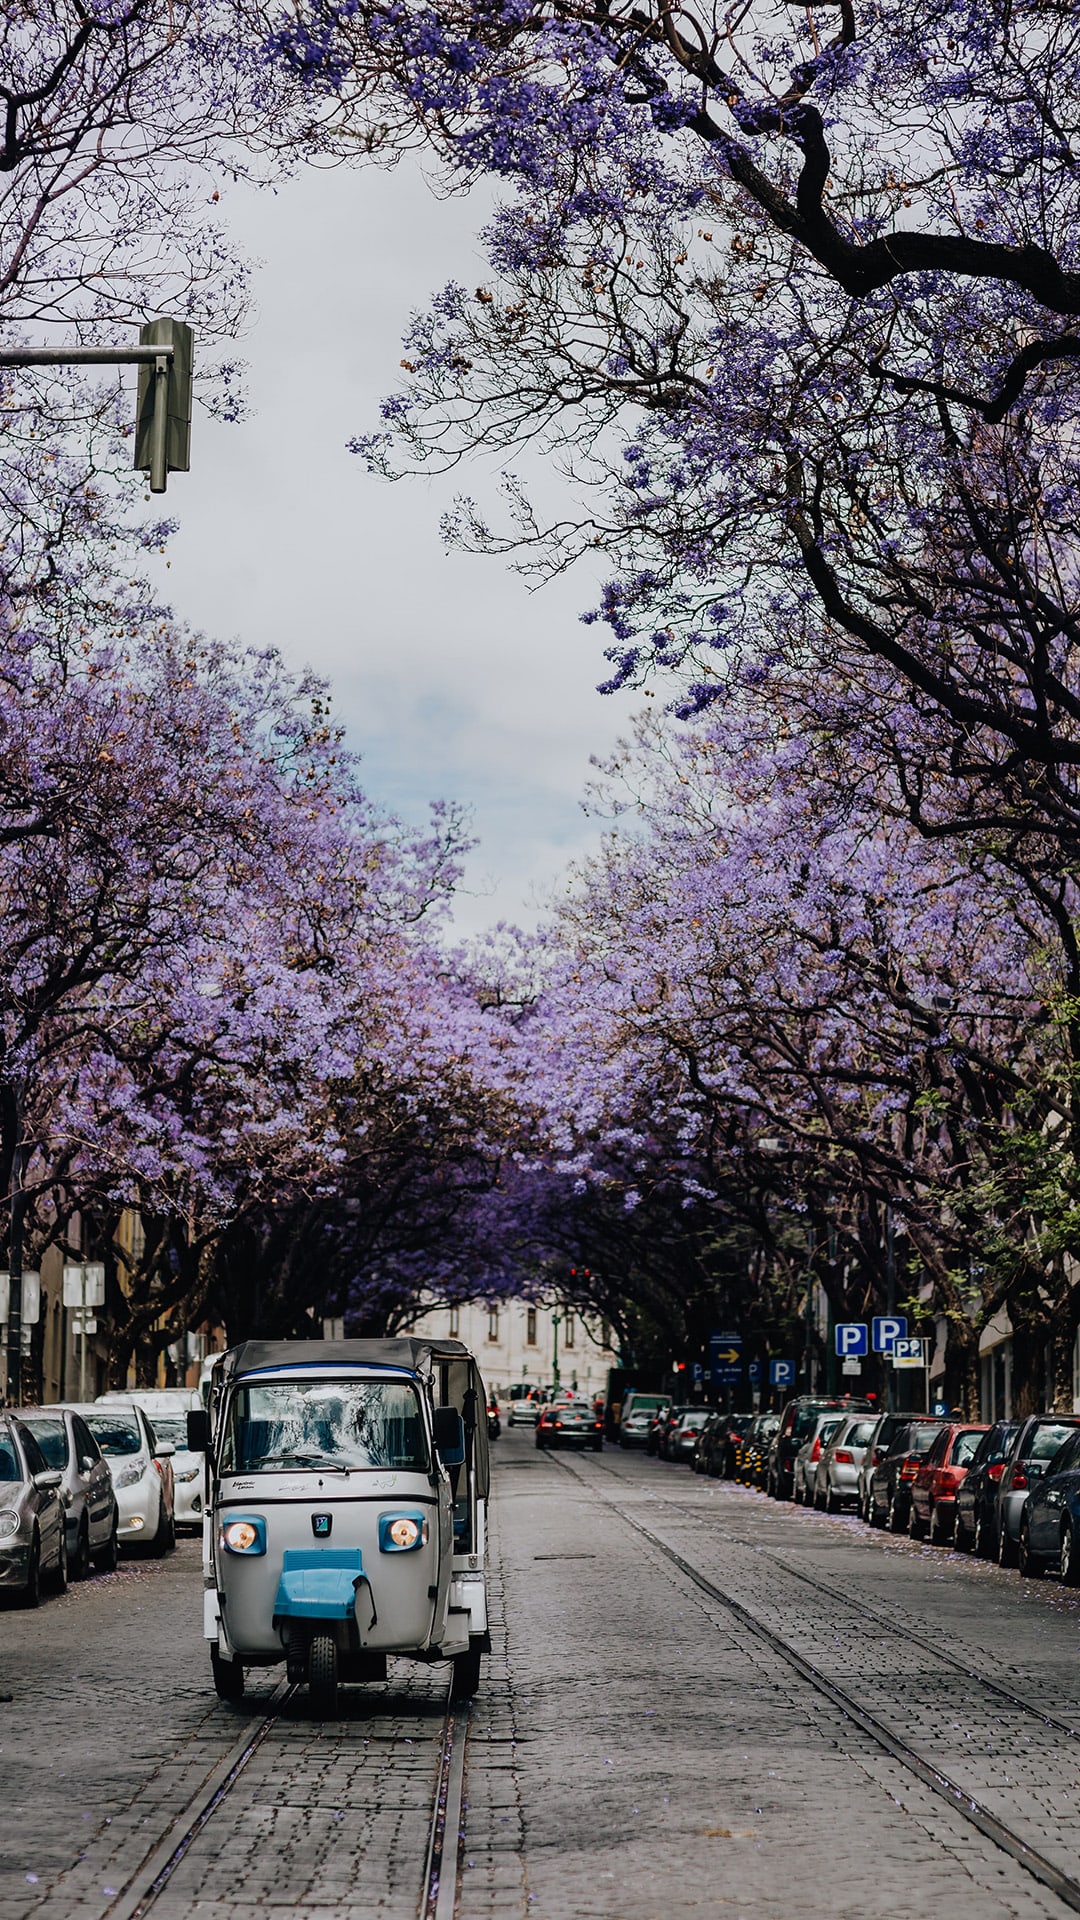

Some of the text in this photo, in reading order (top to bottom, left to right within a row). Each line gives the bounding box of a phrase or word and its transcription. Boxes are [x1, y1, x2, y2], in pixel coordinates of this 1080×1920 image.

[842, 1327, 861, 1353] P
[880, 1320, 900, 1349] P
[896, 1341, 909, 1357] P
[774, 1362, 790, 1382] P
